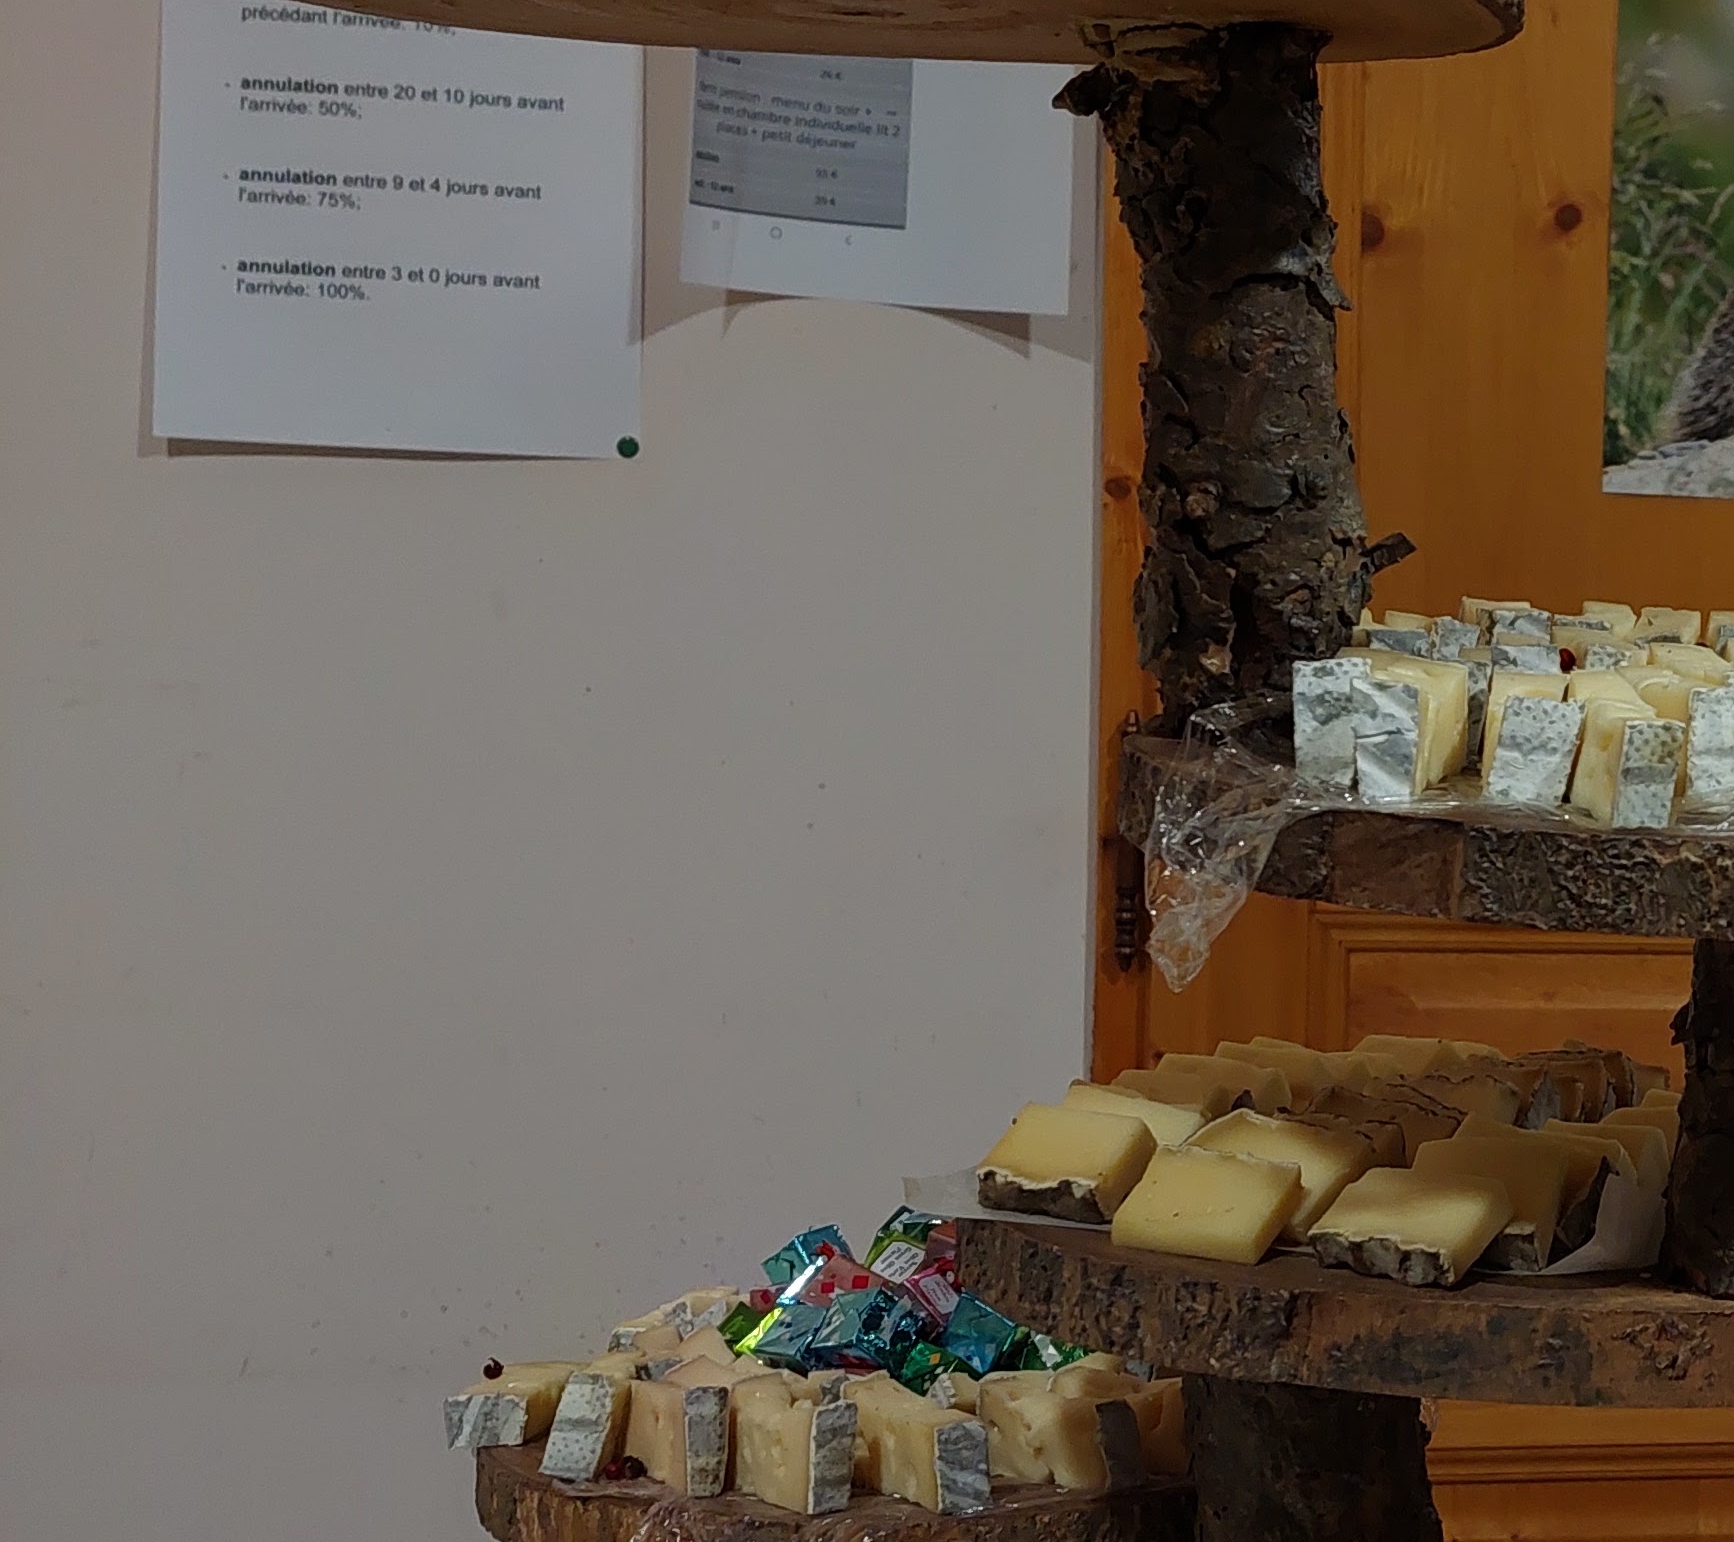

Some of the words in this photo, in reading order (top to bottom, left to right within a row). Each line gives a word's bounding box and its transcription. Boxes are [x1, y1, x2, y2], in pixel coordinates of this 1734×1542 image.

[240, 5, 328, 25] précédant
[240, 77, 340, 96] annulation
[344, 84, 389, 100] entre
[393, 85, 416, 101] 20
[421, 89, 438, 103] et
[444, 88, 465, 105] 10
[468, 90, 513, 110] jours
[517, 97, 565, 112] avant
[770, 96, 811, 112] menu
[813, 100, 832, 114] du
[835, 103, 861, 116] soir
[239, 96, 313, 115] l'arrivée:
[318, 100, 363, 120] 50%;
[736, 107, 792, 125] chambre
[794, 115, 873, 135] individuelle
[876, 123, 889, 136] lit
[891, 125, 901, 137] 2
[761, 128, 793, 144] petit
[796, 133, 858, 150] déjeuner
[239, 168, 338, 187] annulation
[343, 175, 388, 191] entre
[392, 175, 404, 190] 9
[408, 178, 427, 192] et
[430, 177, 441, 193] 4
[445, 179, 490, 198] jours
[494, 184, 542, 200] avant
[238, 186, 312, 207] l'arrivée:
[317, 191, 362, 211] 75%;
[237, 260, 337, 278] annulation
[341, 265, 387, 281] entre
[391, 266, 403, 282] 3
[407, 268, 426, 283] et
[429, 267, 441, 284] 0
[444, 268, 488, 288] jours
[492, 274, 541, 290] avant
[236, 278, 312, 298] l'arrivée:
[317, 282, 371, 301] 100%.
